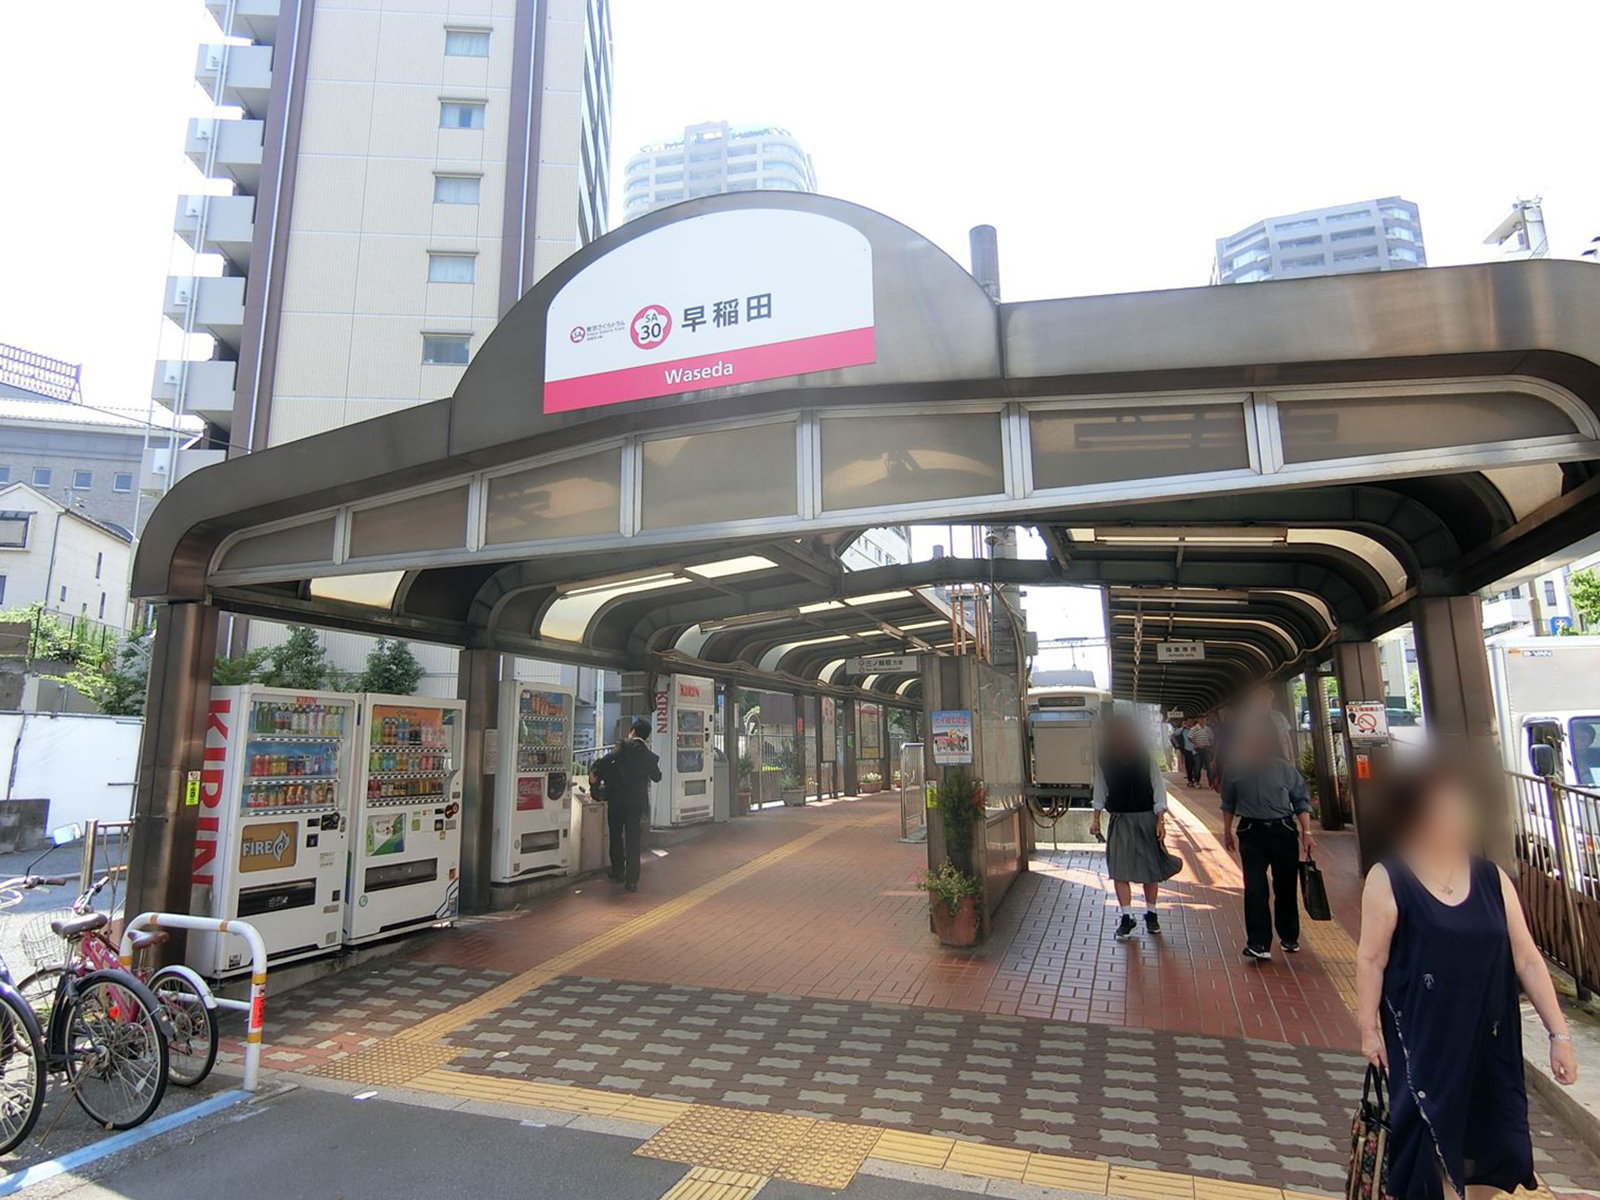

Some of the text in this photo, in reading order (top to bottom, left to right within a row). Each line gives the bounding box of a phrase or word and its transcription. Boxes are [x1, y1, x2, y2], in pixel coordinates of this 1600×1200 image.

[645, 312, 659, 324] SA
[681, 292, 773, 333] 早稲田
[640, 322, 662, 341] 30
[664, 361, 735, 385] Waseda
[656, 691, 668, 734] KIRIN
[192, 698, 232, 886] KIRIN
[242, 840, 274, 856] FIRE
